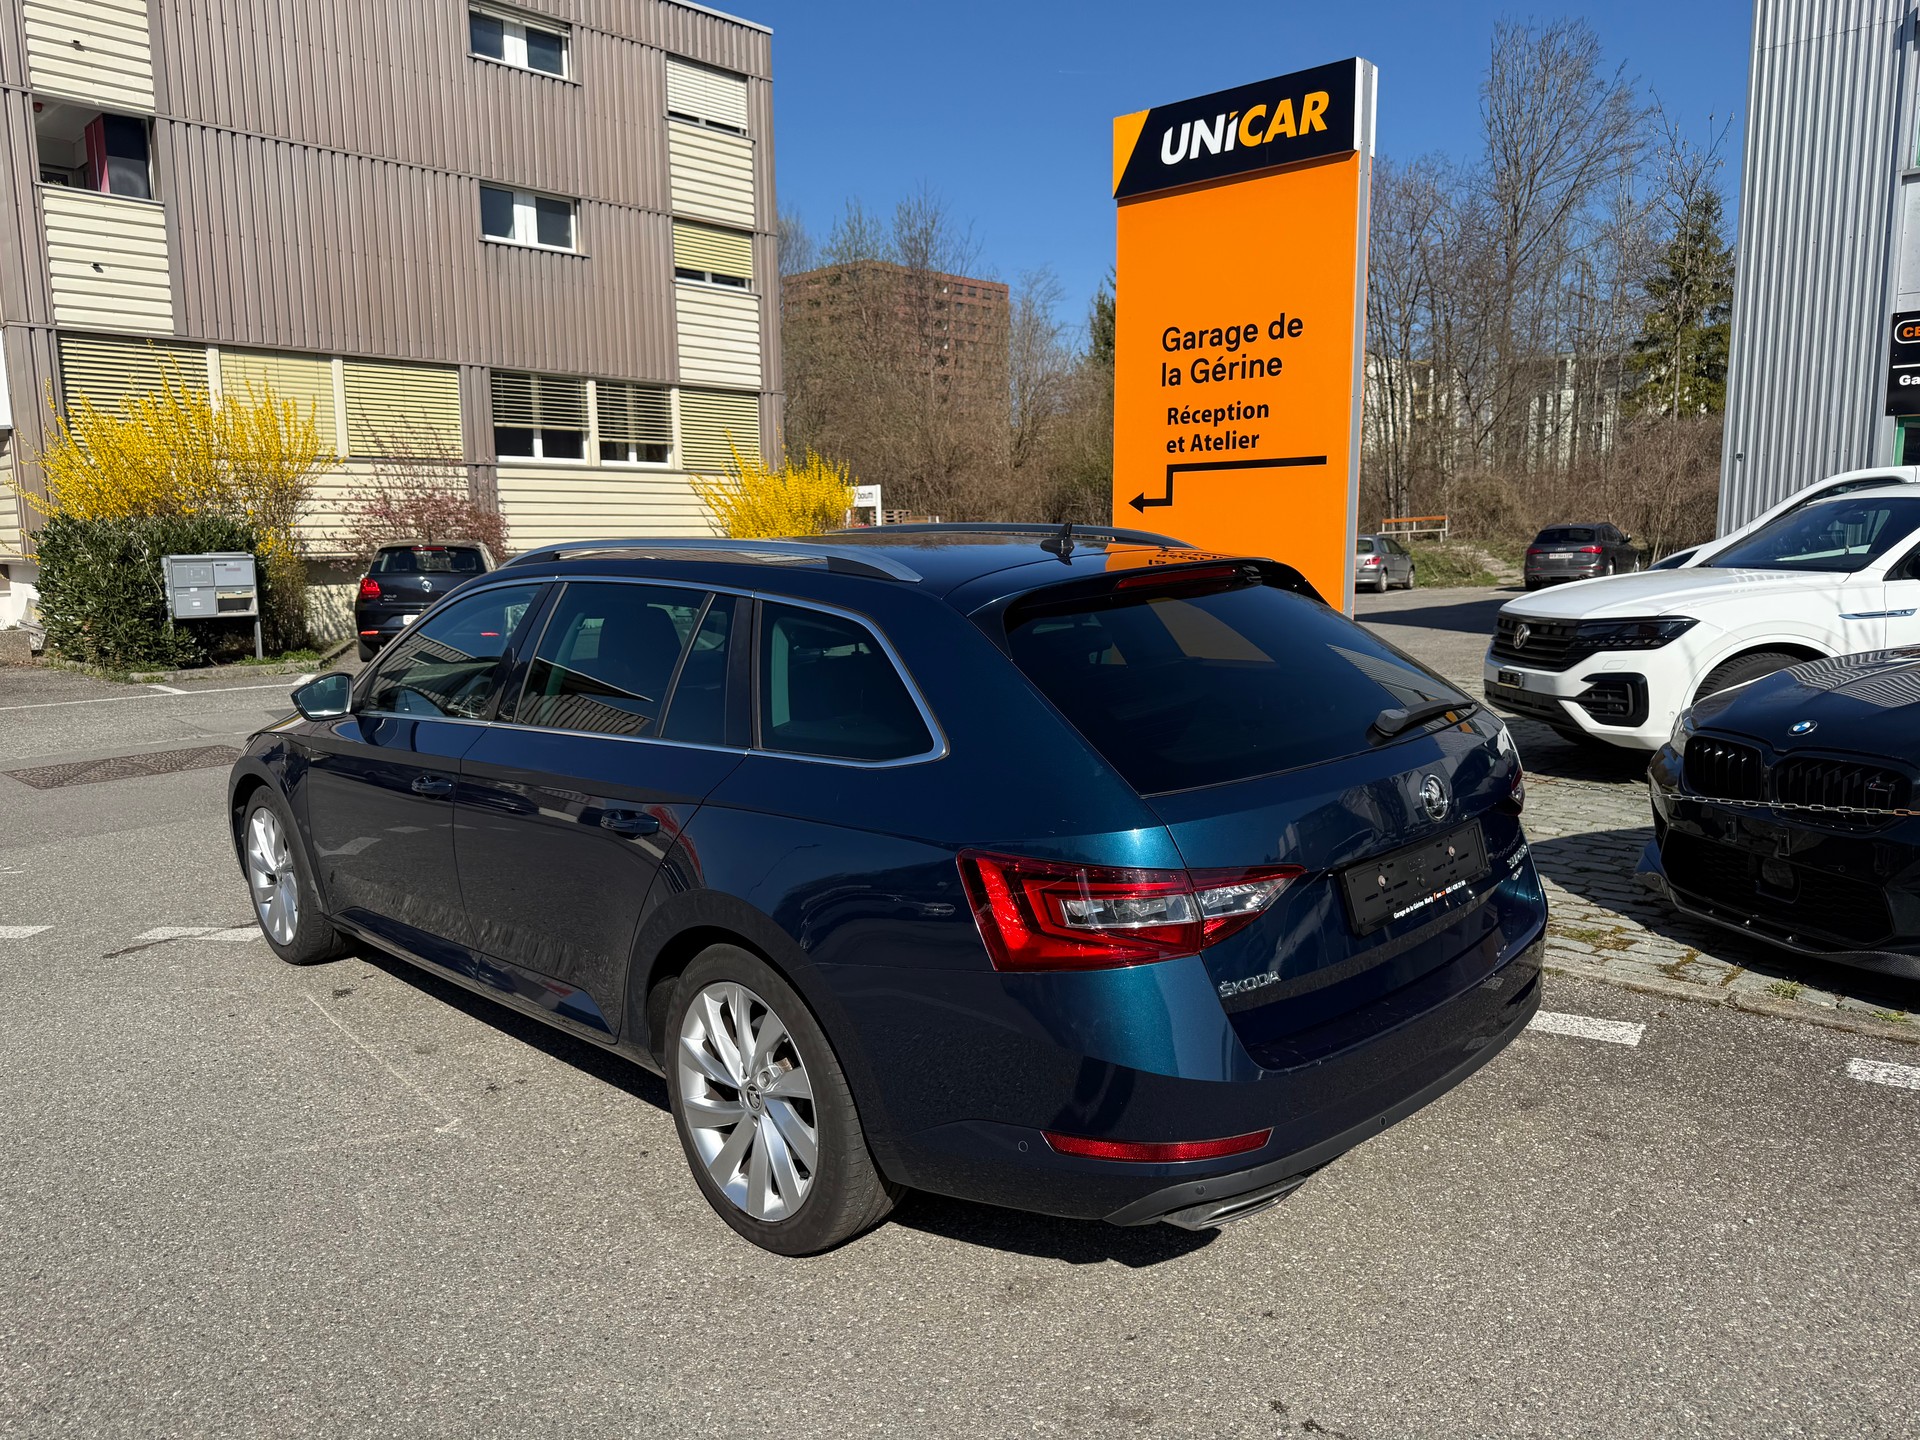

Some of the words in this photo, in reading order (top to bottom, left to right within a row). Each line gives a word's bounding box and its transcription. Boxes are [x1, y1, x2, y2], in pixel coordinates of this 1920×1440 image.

[1162, 323, 1258, 352] Garage
[1268, 312, 1303, 340] de
[1161, 362, 1182, 387] la
[1190, 353, 1283, 384] Gérine
[1167, 400, 1269, 427] Réception
[1166, 436, 1185, 453] et
[1190, 430, 1260, 452] Atelier
[1219, 970, 1282, 998] ŠKODA
